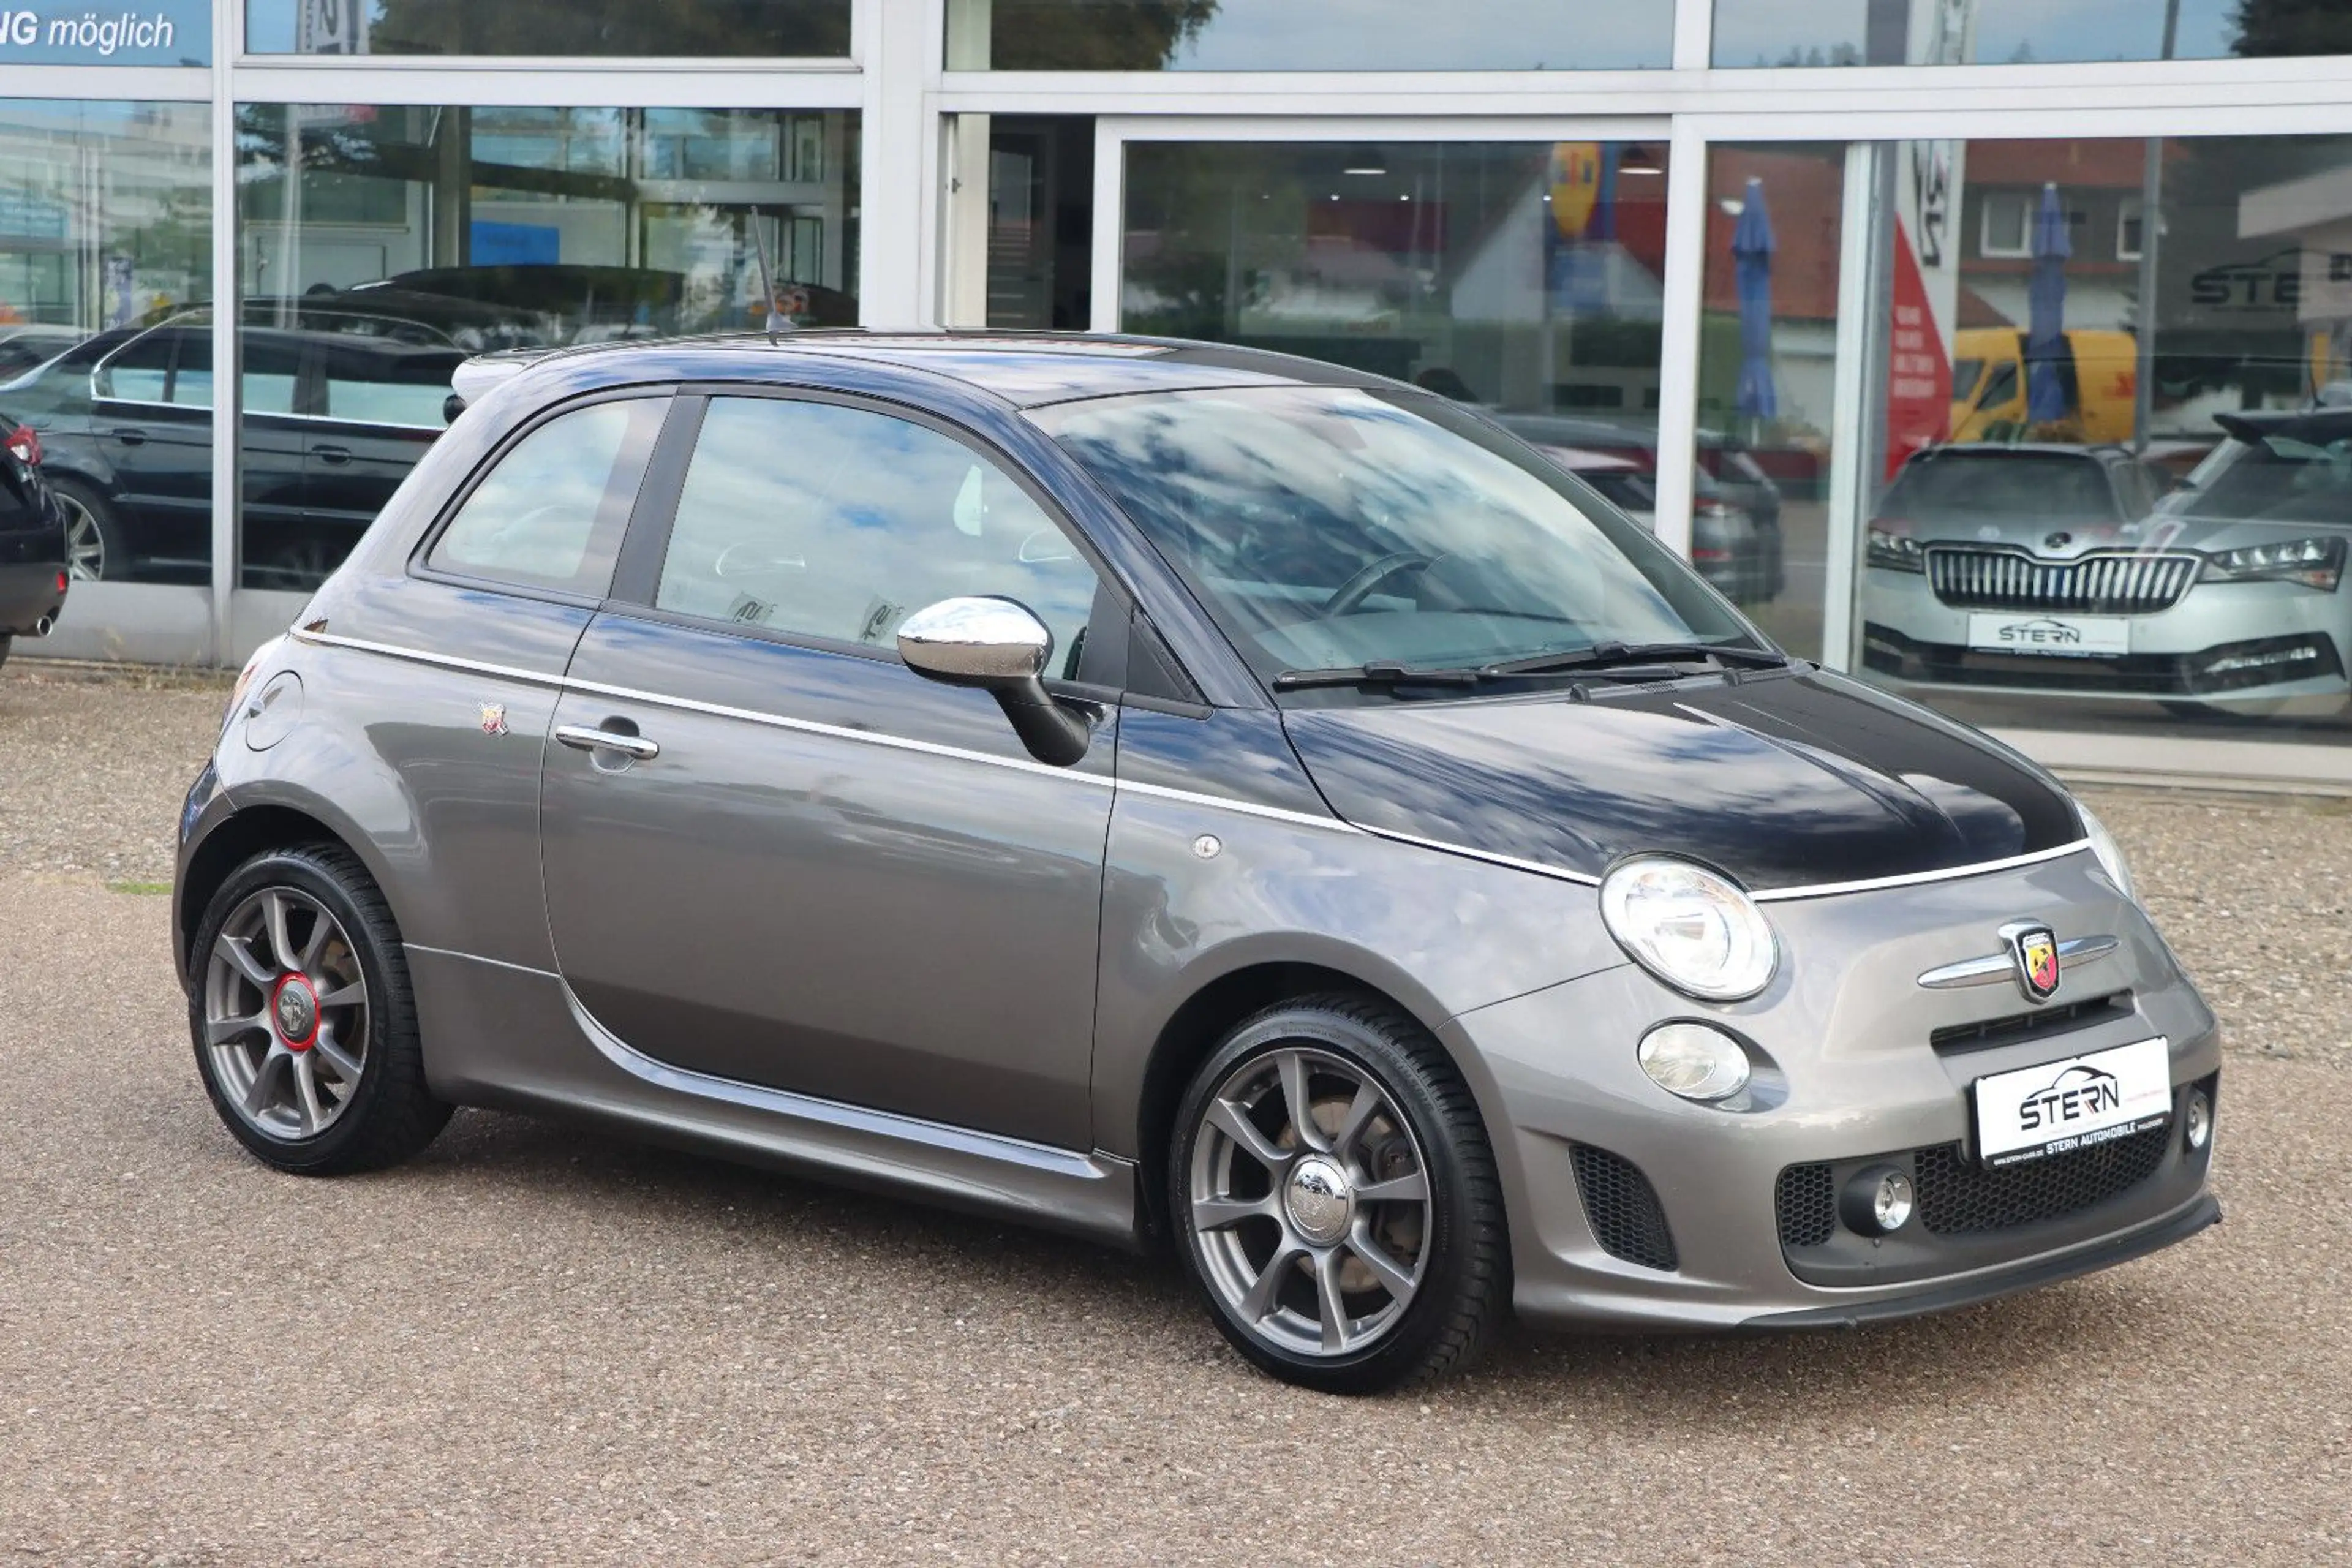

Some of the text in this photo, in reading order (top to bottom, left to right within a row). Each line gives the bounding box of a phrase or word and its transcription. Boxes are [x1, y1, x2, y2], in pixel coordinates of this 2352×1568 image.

[48, 12, 173, 55] möglich
[1999, 627, 2081, 644] STERN
[2019, 1080, 2120, 1131] STERN
[2046, 1137, 2078, 1155] STERN
[2080, 1121, 2136, 1147] AUTOMOBILE
